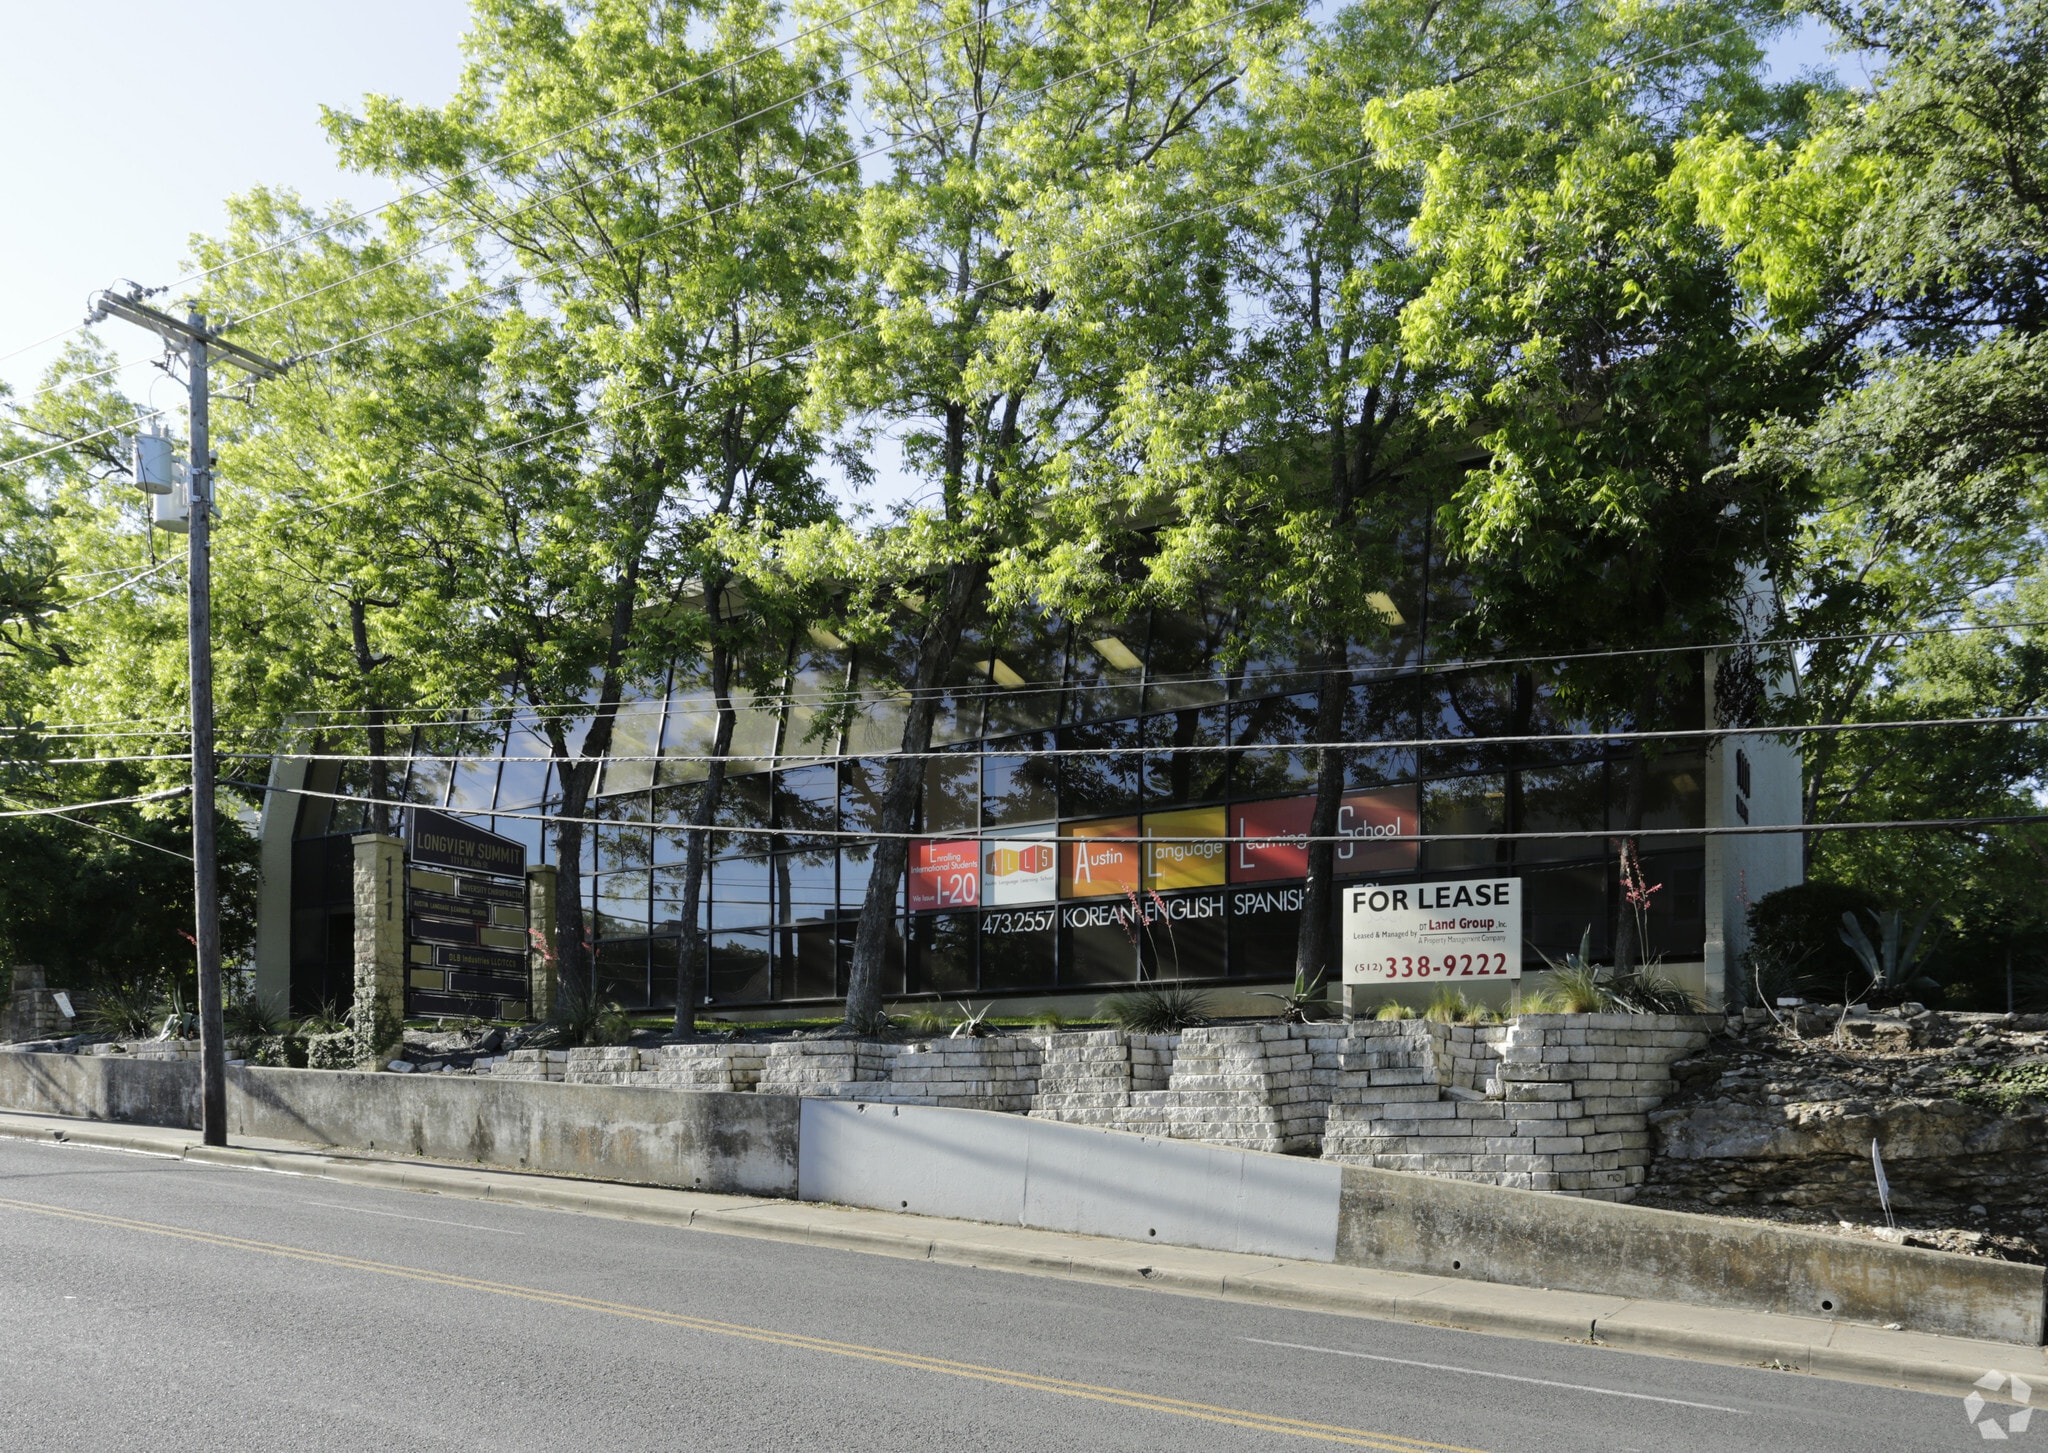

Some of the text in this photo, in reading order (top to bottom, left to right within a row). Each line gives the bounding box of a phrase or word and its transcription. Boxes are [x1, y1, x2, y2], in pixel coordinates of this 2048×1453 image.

[417, 832, 520, 864] LONGVIEW SUMMIT
[930, 839, 961, 863] Enrolling
[1075, 835, 1123, 885] Austin
[1148, 828, 1223, 878] Language
[1338, 806, 1401, 859] School
[911, 861, 978, 874] International Students
[937, 873, 976, 905] I-20
[1353, 883, 1509, 913] FOR LEASE
[982, 910, 1056, 934] 473.2557
[1063, 905, 1135, 928] KOREAN
[1145, 896, 1223, 922] ENGLISH
[1419, 923, 1427, 931] DT
[1429, 918, 1456, 930] Land
[1382, 930, 1409, 939] Managed
[1410, 930, 1418, 938] by
[1424, 936, 1446, 945] Property
[1448, 936, 1481, 944] Management
[1482, 934, 1506, 943] Company
[463, 954, 489, 965] Industries
[1354, 953, 1507, 978] (512) 338-9222
